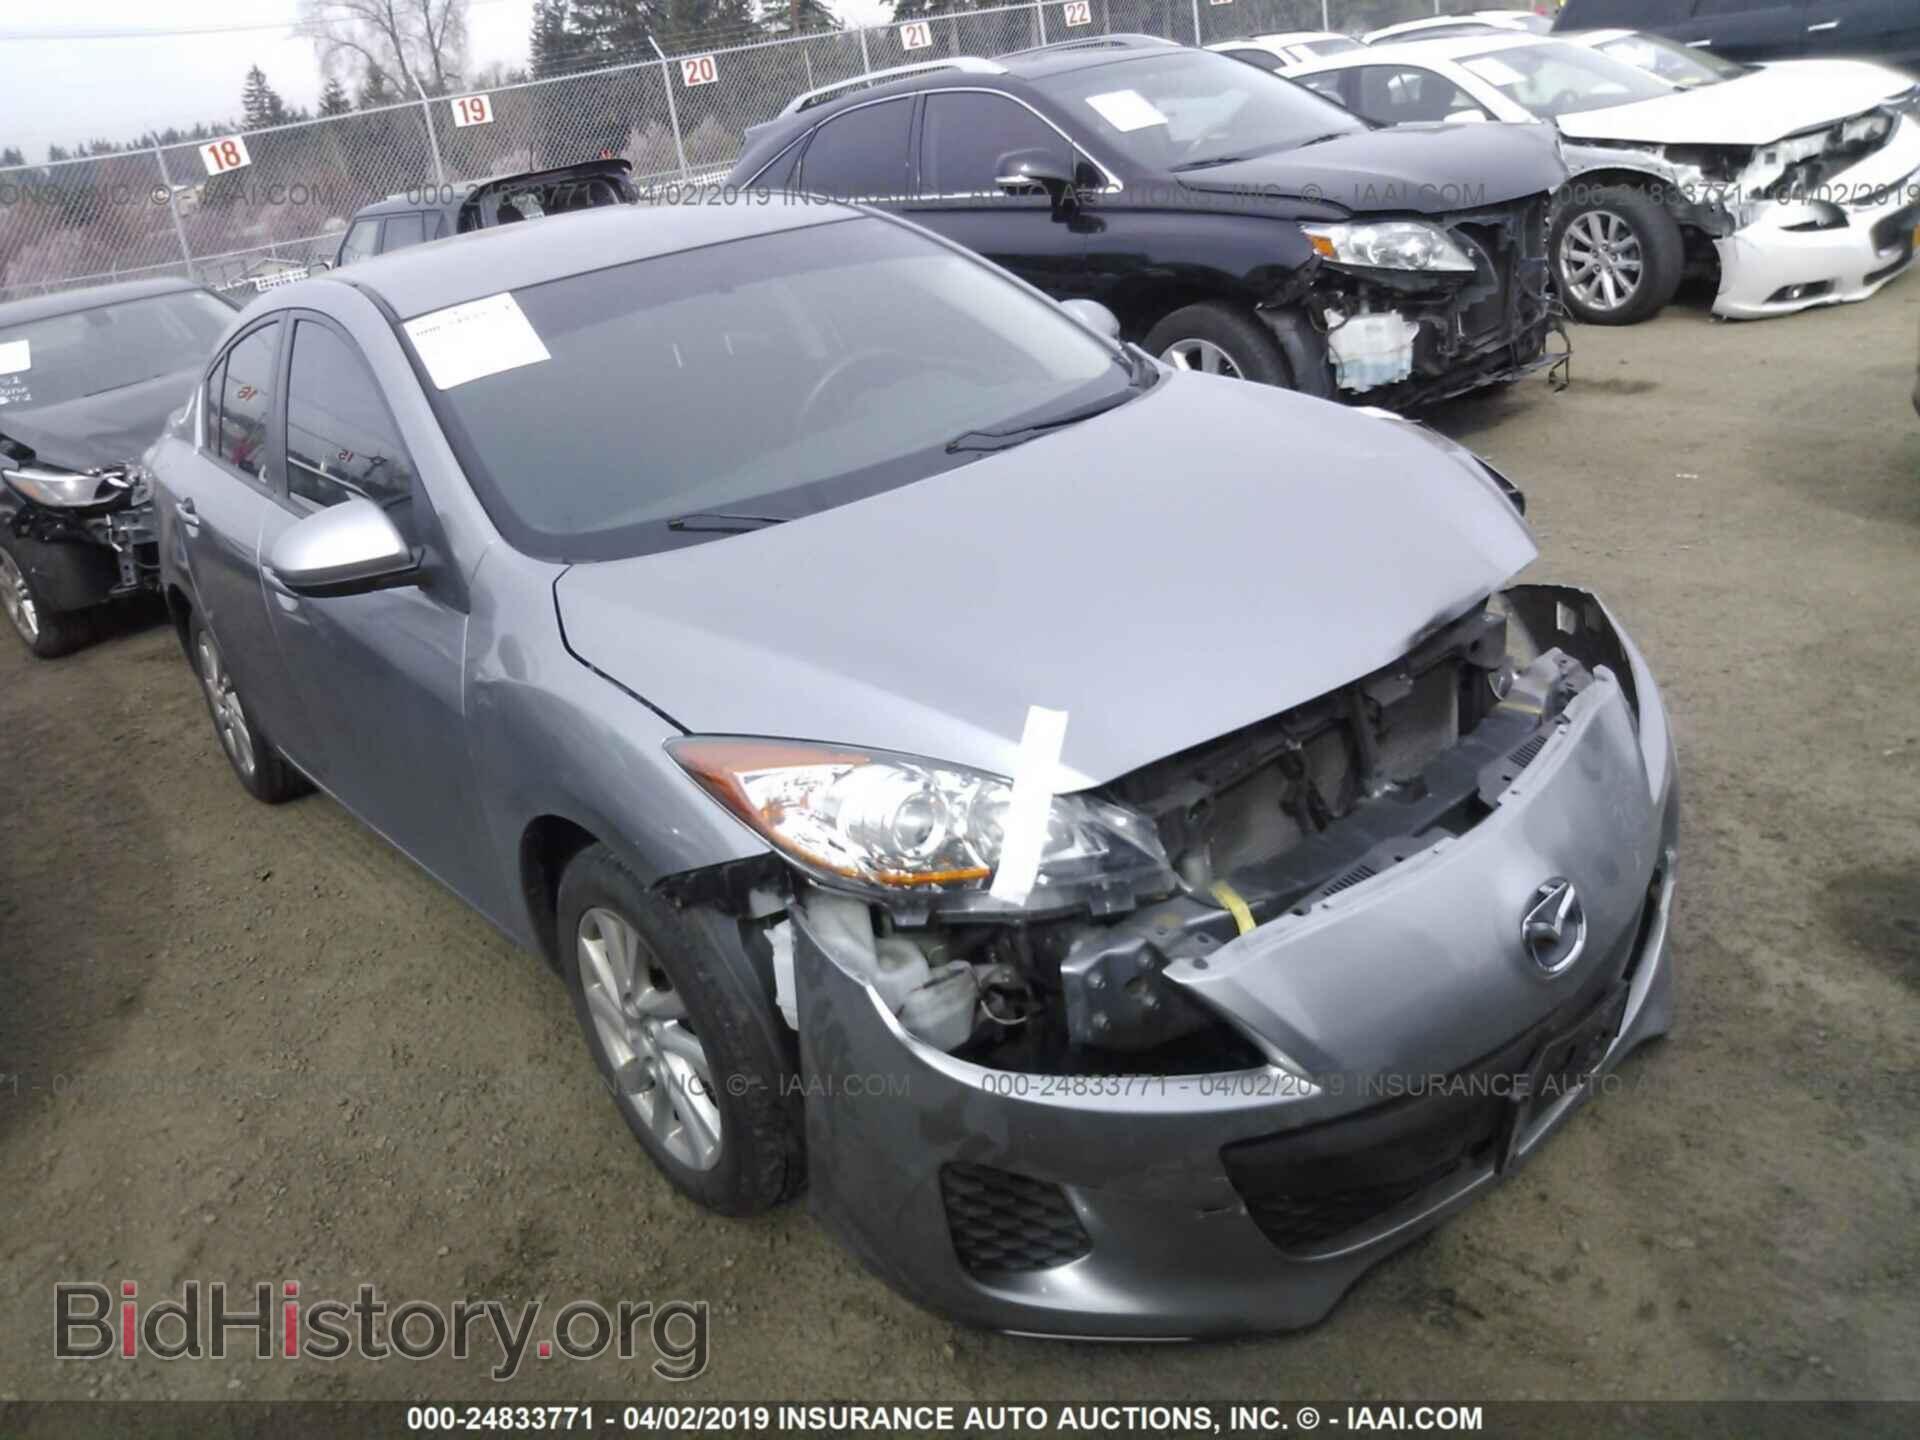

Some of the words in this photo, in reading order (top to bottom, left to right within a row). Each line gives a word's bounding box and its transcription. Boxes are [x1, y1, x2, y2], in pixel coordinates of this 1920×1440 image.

[1067, 3, 1088, 24] 22
[906, 24, 926, 46] 21
[686, 58, 713, 83] 20
[458, 98, 485, 124] 19
[208, 140, 241, 170] 18
